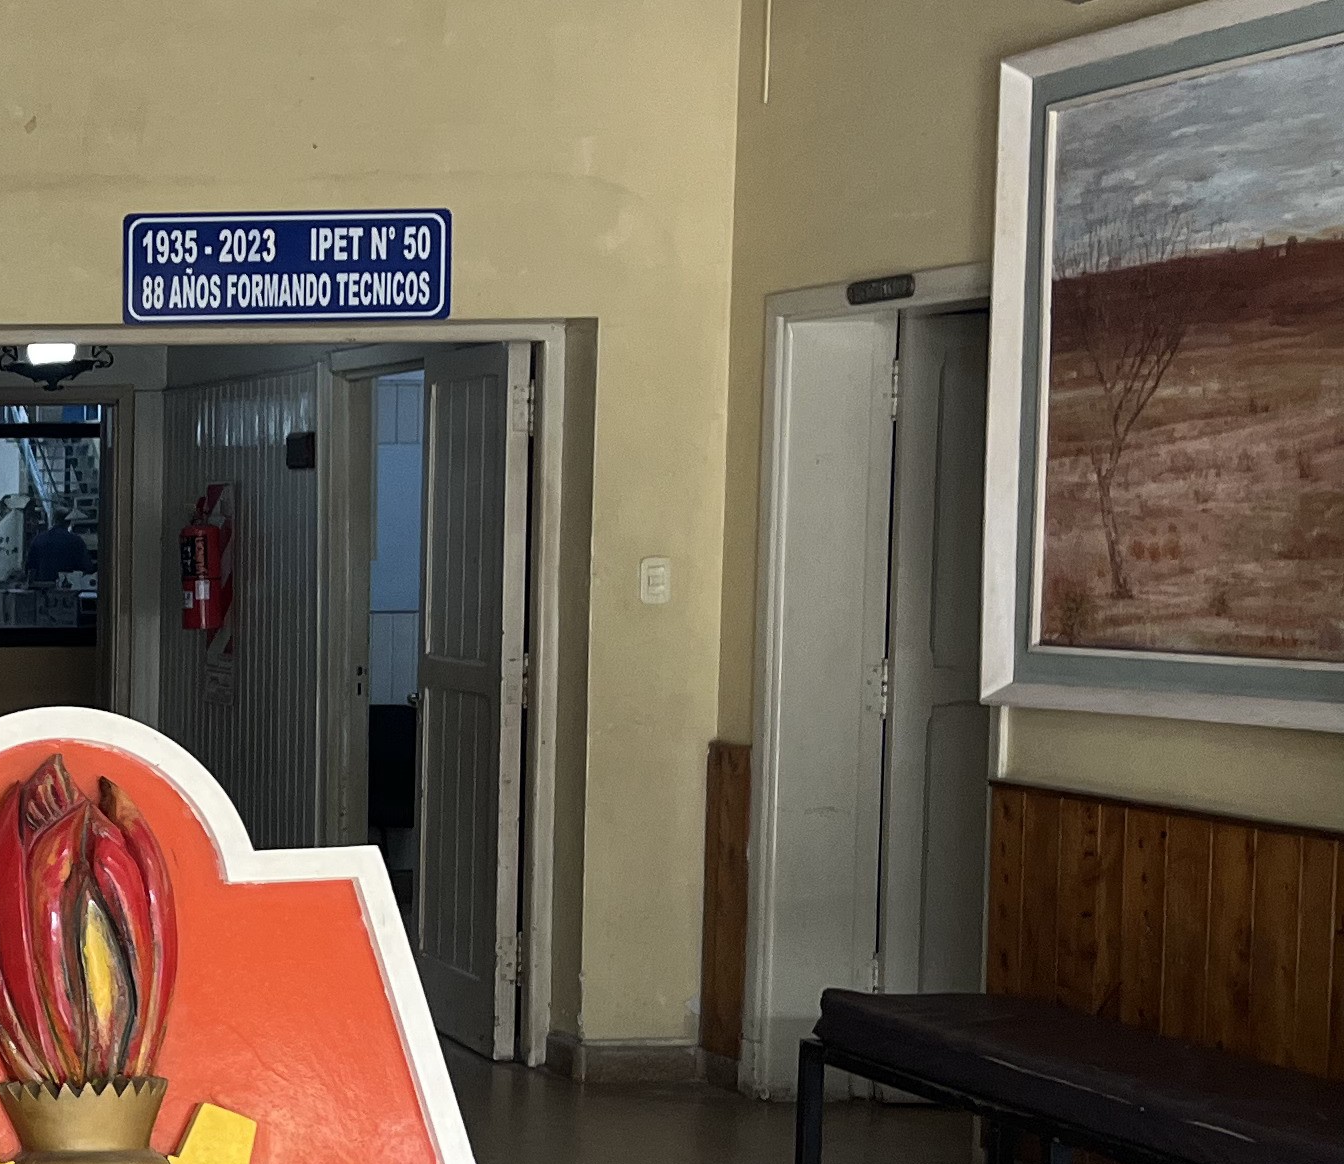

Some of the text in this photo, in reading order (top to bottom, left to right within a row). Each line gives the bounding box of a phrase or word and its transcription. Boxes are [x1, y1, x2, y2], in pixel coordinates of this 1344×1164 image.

[142, 229, 198, 263] 1935
[218, 228, 276, 262] 2023
[310, 227, 363, 261] IPET
[403, 225, 431, 260] 50
[142, 267, 430, 309] 88 AÑOS FORMANDO TECNICOS
